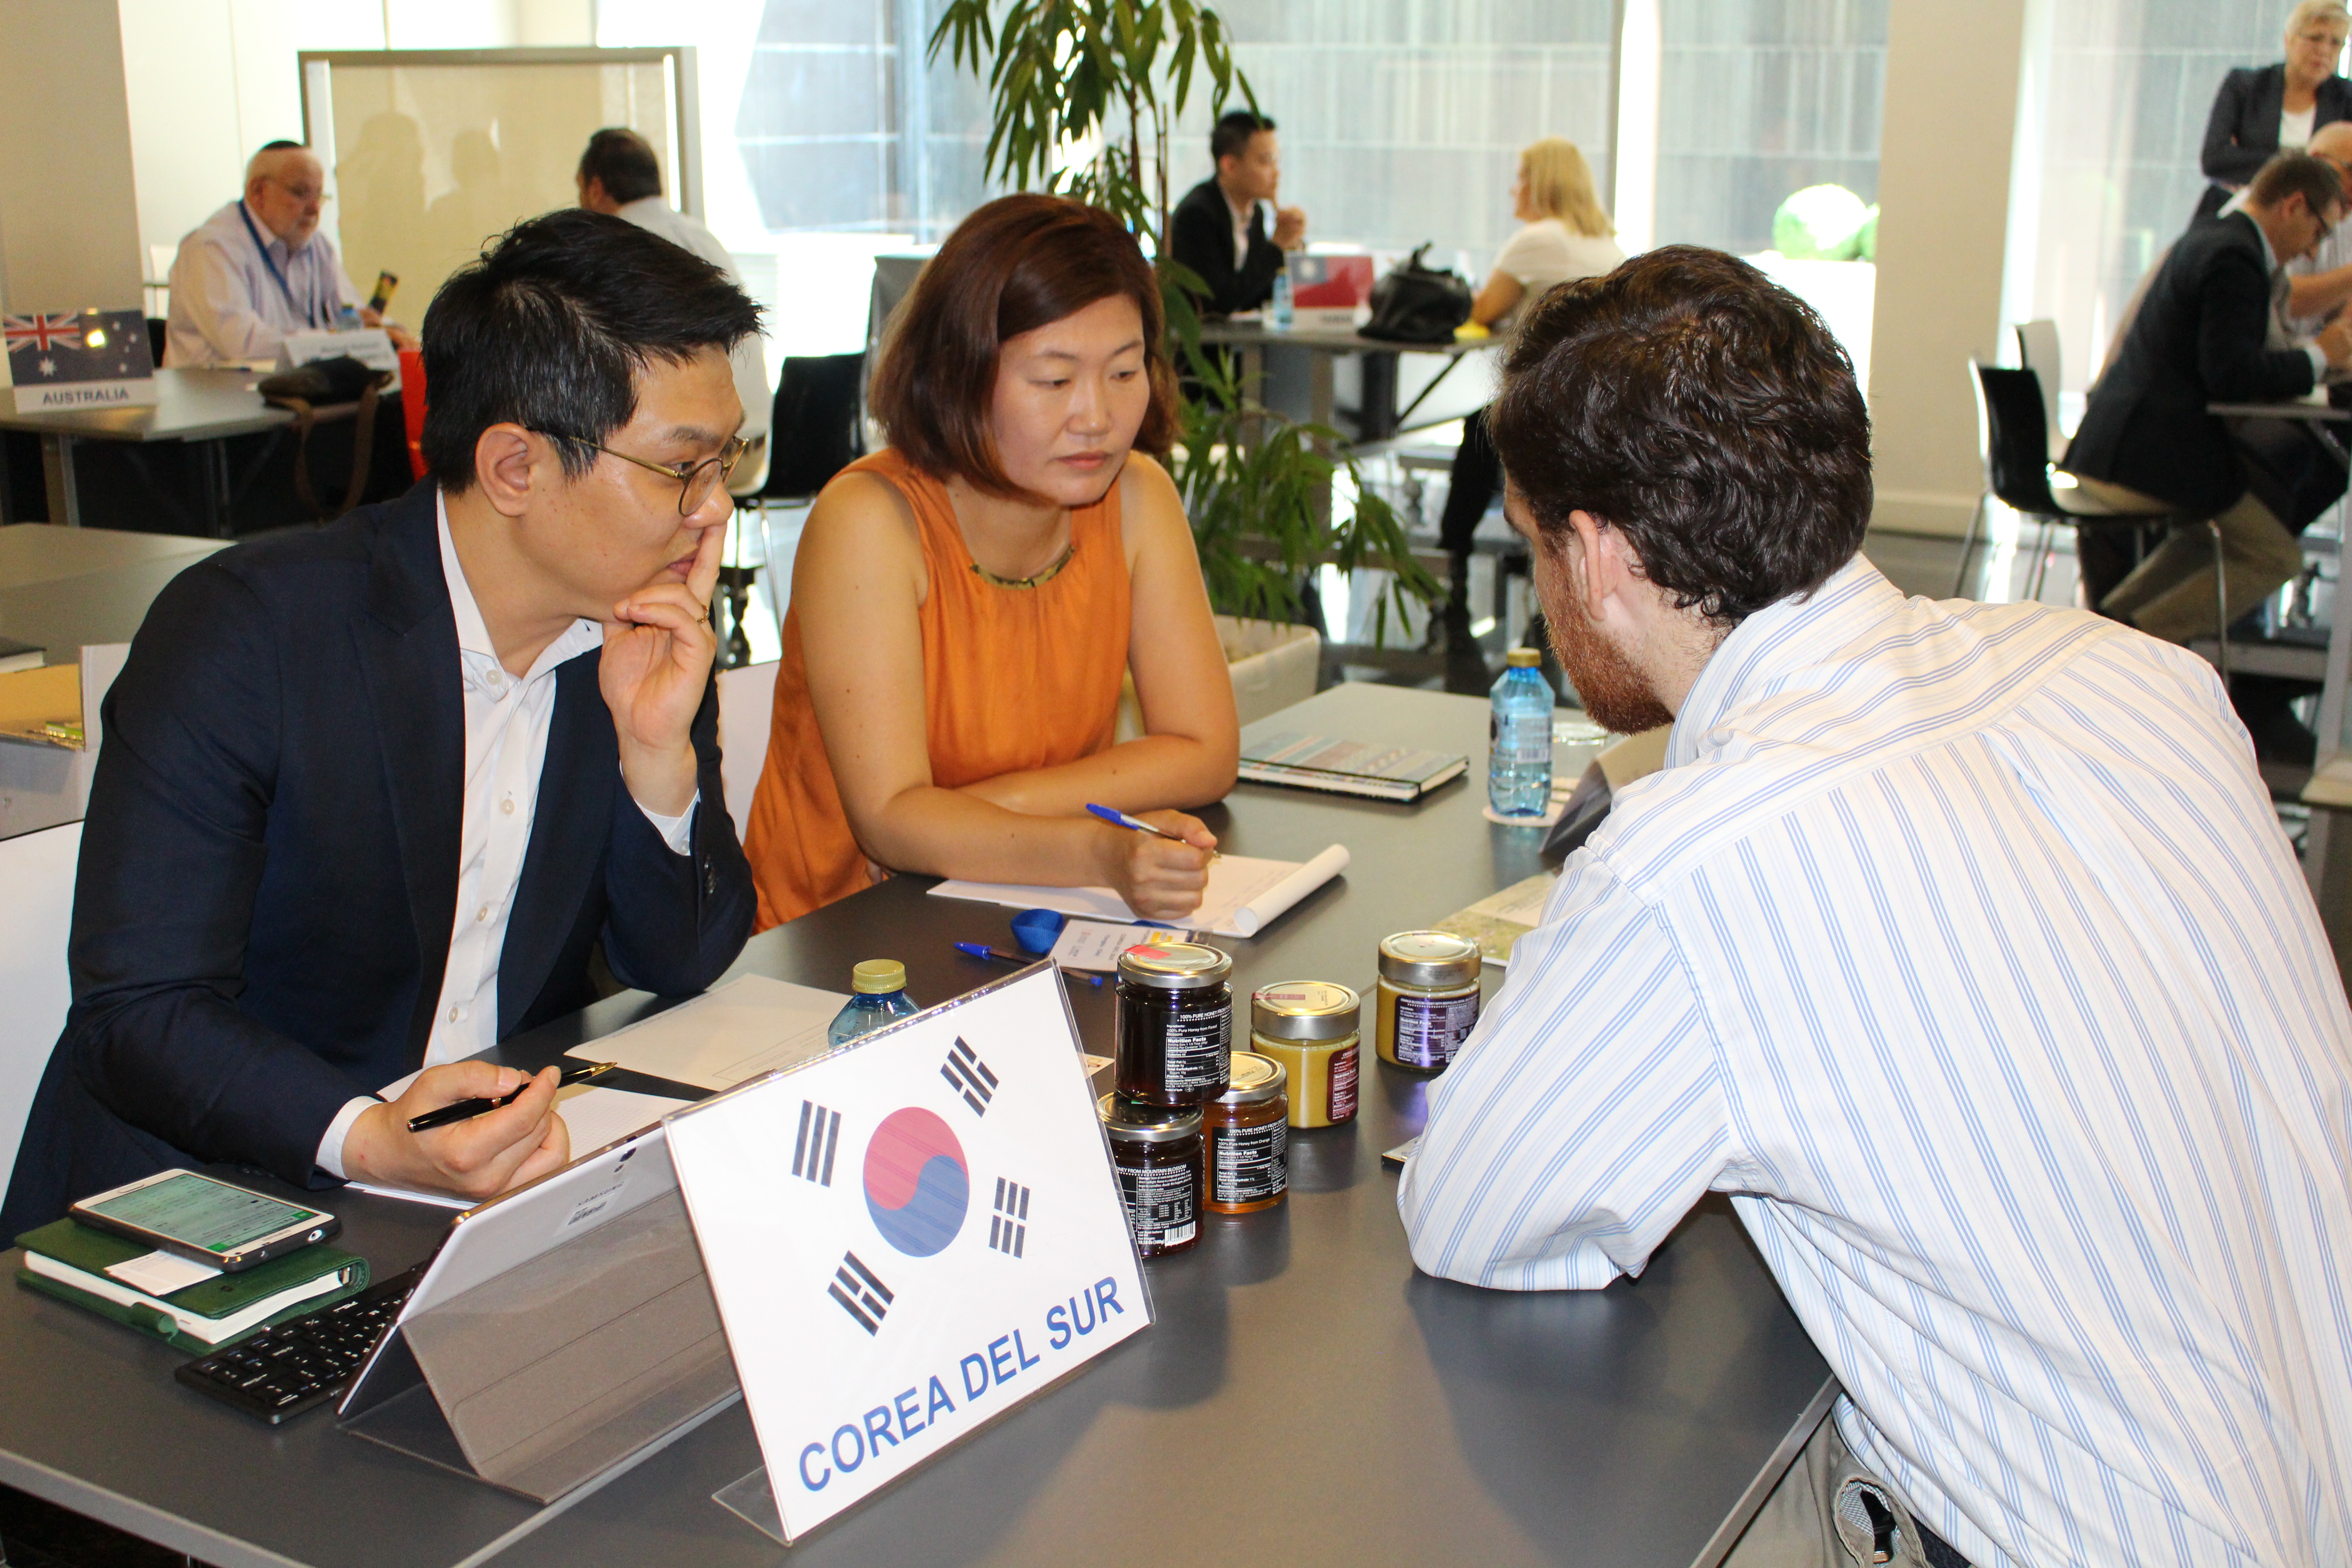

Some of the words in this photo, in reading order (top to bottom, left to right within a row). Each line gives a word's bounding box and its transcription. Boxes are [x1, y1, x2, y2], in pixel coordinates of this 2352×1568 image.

[43, 387, 129, 405] AUSTRALIA
[1167, 1164, 1186, 1172] BLOSSOM
[576, 1181, 624, 1207] SAMSUNG
[799, 1375, 956, 1491] COREA
[960, 1329, 1040, 1401] DEL
[1046, 1276, 1124, 1350] SUR
